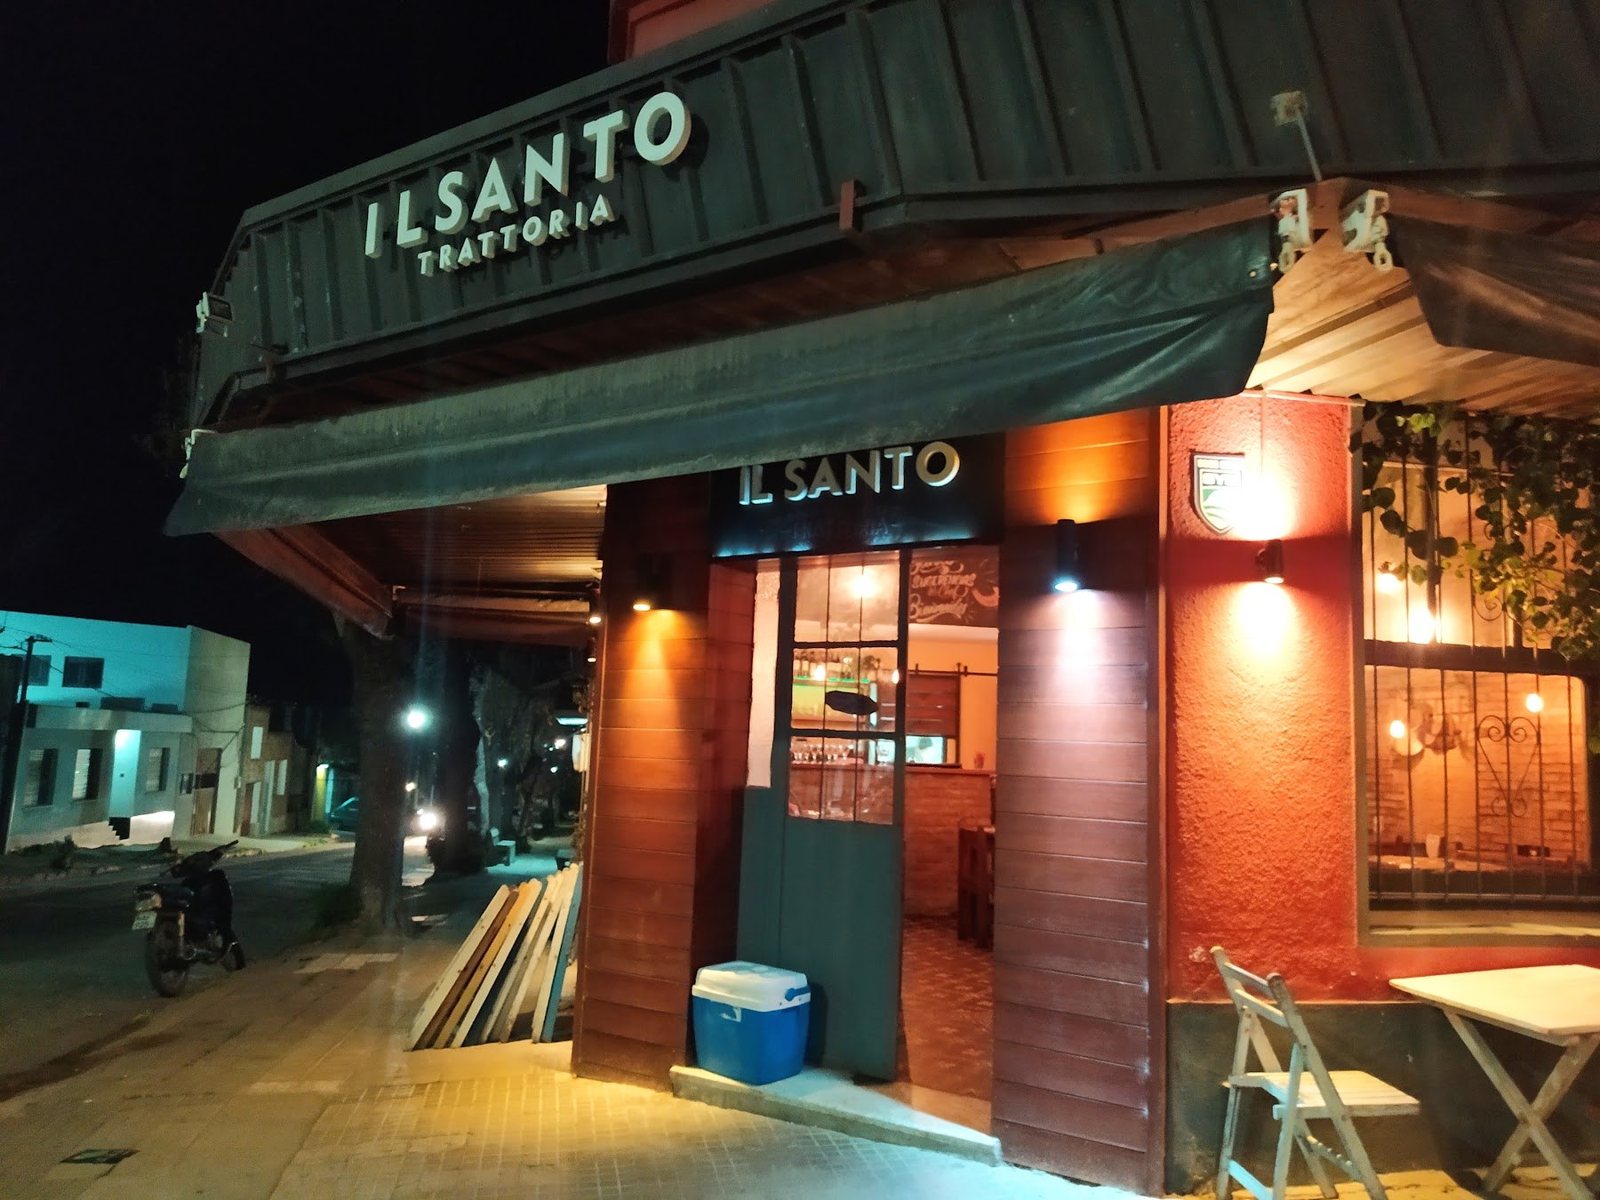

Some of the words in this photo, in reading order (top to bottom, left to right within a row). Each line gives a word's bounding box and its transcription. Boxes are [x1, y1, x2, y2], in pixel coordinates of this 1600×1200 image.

[365, 190, 428, 259] IL
[435, 91, 692, 235] SANTO
[417, 194, 616, 277] TRATTORIA
[738, 464, 774, 506] IL
[784, 441, 961, 502] SANTO
